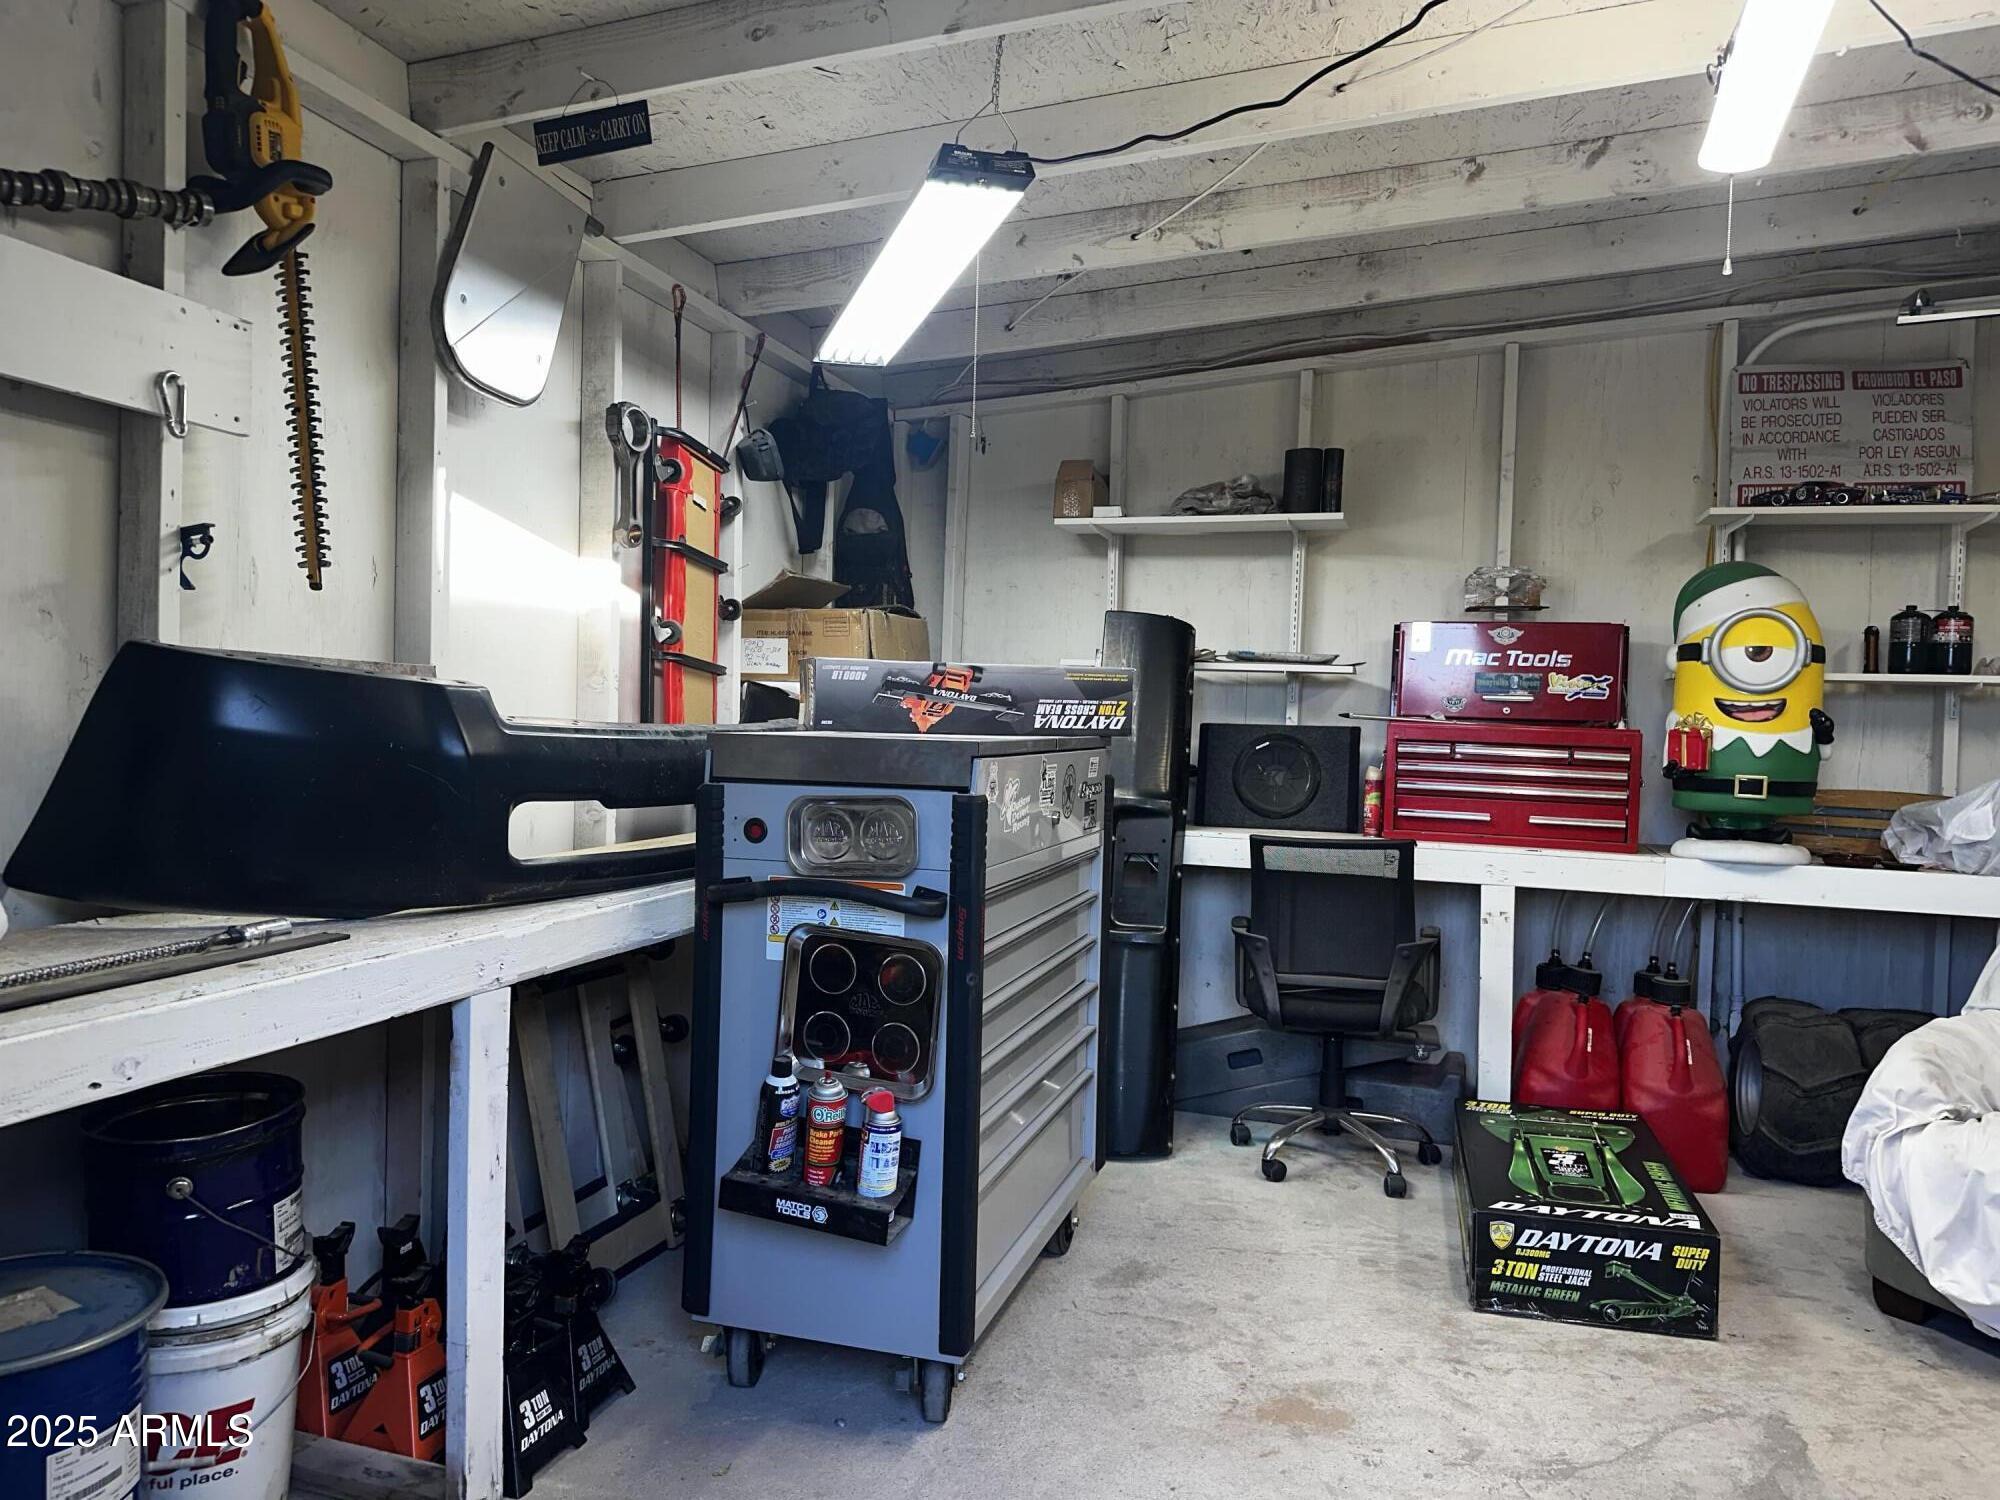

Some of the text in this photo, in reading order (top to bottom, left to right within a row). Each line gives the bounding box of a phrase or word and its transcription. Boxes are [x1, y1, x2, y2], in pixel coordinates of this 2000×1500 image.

[536, 112, 647, 155] KEEP CALM CARRY ON
[1742, 372, 1842, 391] NO TRESPASSING
[1857, 368, 1958, 389] PROHIBIDO EL PASO
[1743, 397, 1841, 412] VIOLATORS WILL
[1872, 393, 1945, 406] VIOLADORES
[1741, 413, 1842, 429] BE PROSECUTED
[1872, 409, 1946, 424] PUEDEN SER
[1743, 430, 1841, 445] IN ACCORDANCE
[1873, 428, 1946, 442] CASTIGADOS
[1777, 448, 1807, 461] WITH
[1859, 445, 1961, 460] POR LEY ASEGUN
[1743, 466, 1775, 479] A.R.S.
[1444, 650, 1573, 668] Mac Tools
[932, 688, 978, 702] DAYTONA
[1035, 704, 1063, 715] BEAM
[1064, 704, 1097, 716] CROSS
[1098, 704, 1116, 716] TON
[1115, 700, 1128, 717] 2
[1033, 714, 1129, 730] DAYTONA
[809, 1128, 829, 1139] Brake
[809, 1136, 836, 1146] Cleaner
[776, 1198, 812, 1211] MATCO
[776, 1206, 811, 1219] TOOLS
[1488, 1201, 1702, 1231] DAYTONA
[1515, 1229, 1663, 1262] DAYTONA
[1672, 1245, 1711, 1259] SUPER
[1491, 1258, 1540, 1281] 3 TON
[1540, 1264, 1593, 1278] PROFESSIONAL
[1676, 1257, 1707, 1271] DUTY
[1538, 1271, 1591, 1287] STEEL JACK
[1489, 1281, 1581, 1302] METALLIC GREEN
[577, 1335, 605, 1372] 3 TON
[330, 1361, 348, 1390] 3
[579, 1354, 618, 1392] DAYTONA
[330, 1373, 378, 1411] DAYTONA
[420, 1384, 436, 1414] 3
[519, 1399, 536, 1430] 3
[530, 1389, 550, 1412] TON
[420, 1410, 447, 1436] DAYT
[521, 1409, 565, 1453] DAYTONA
[180, 1467, 240, 1490] place.
